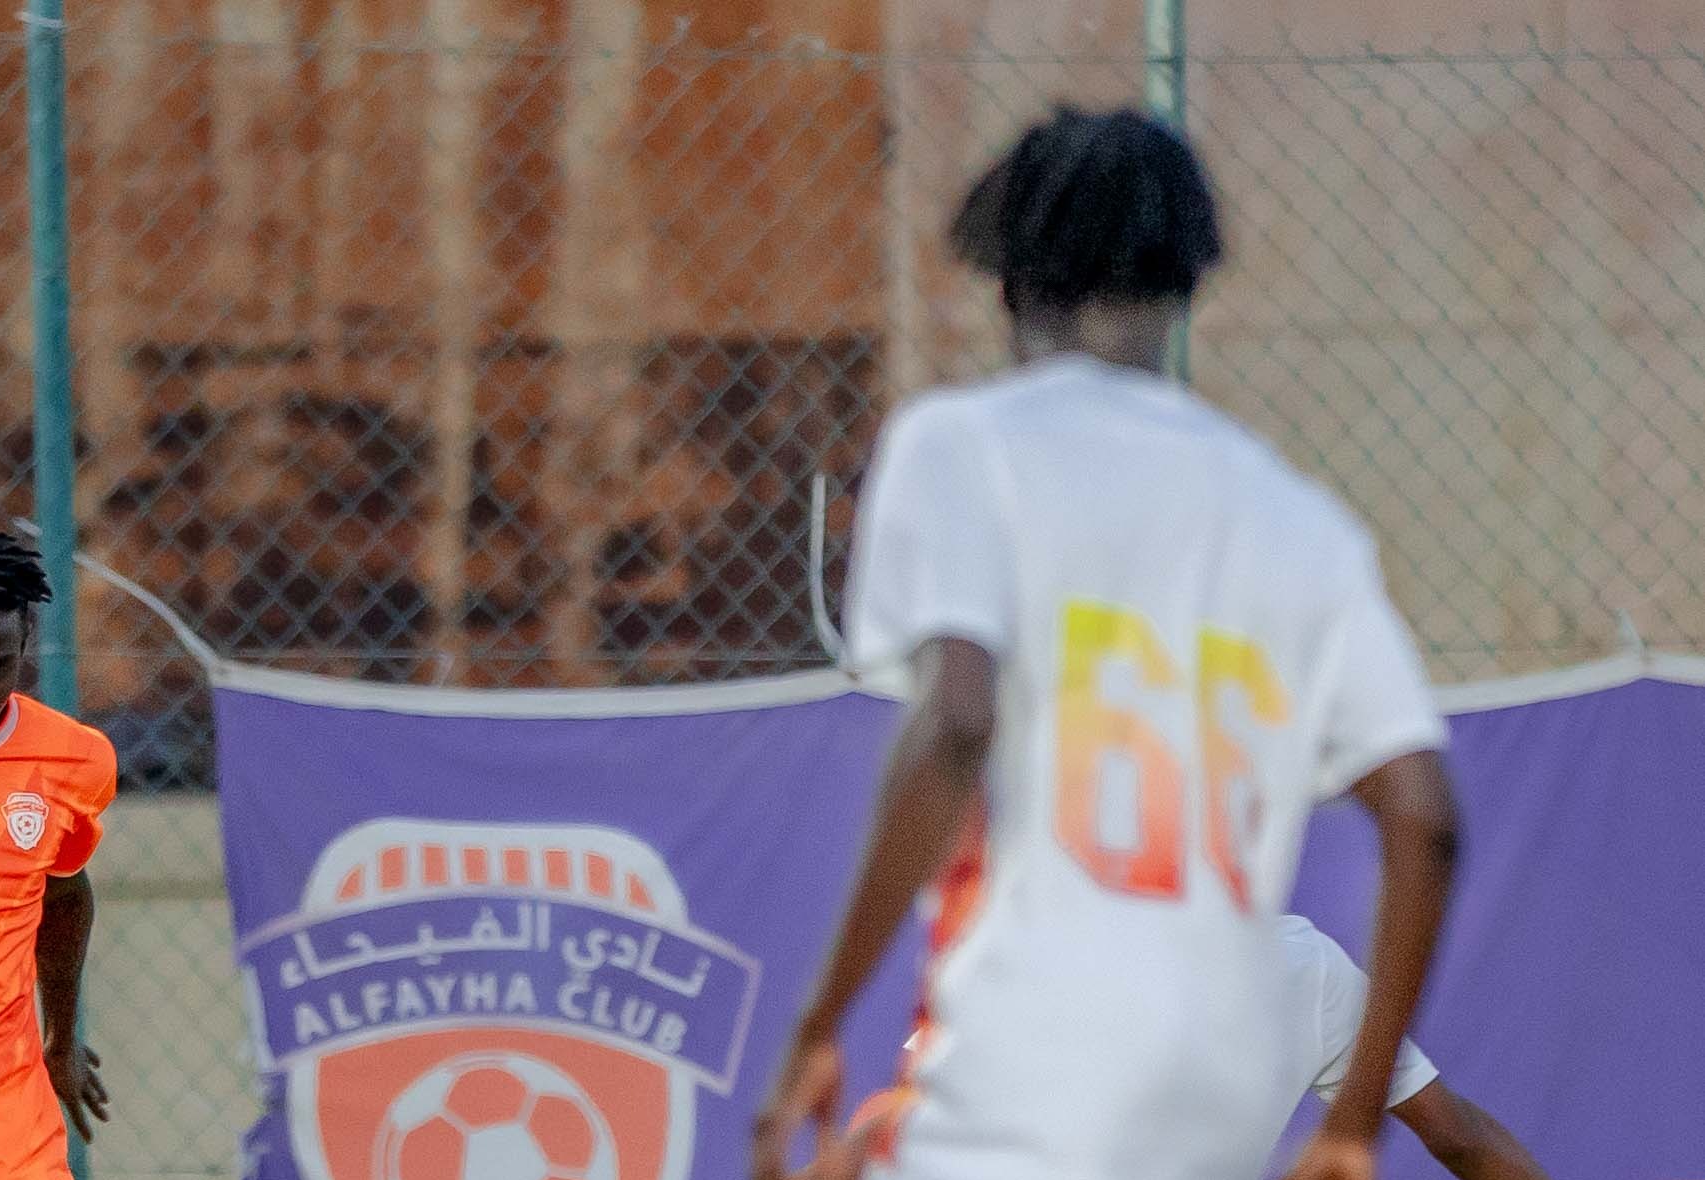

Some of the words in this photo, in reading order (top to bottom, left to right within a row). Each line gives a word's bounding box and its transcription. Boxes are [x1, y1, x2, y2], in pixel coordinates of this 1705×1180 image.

[280, 902, 551, 989] الفيحاء
[295, 972, 538, 1043] ALFAYHA
[557, 978, 687, 1055] CLUB
